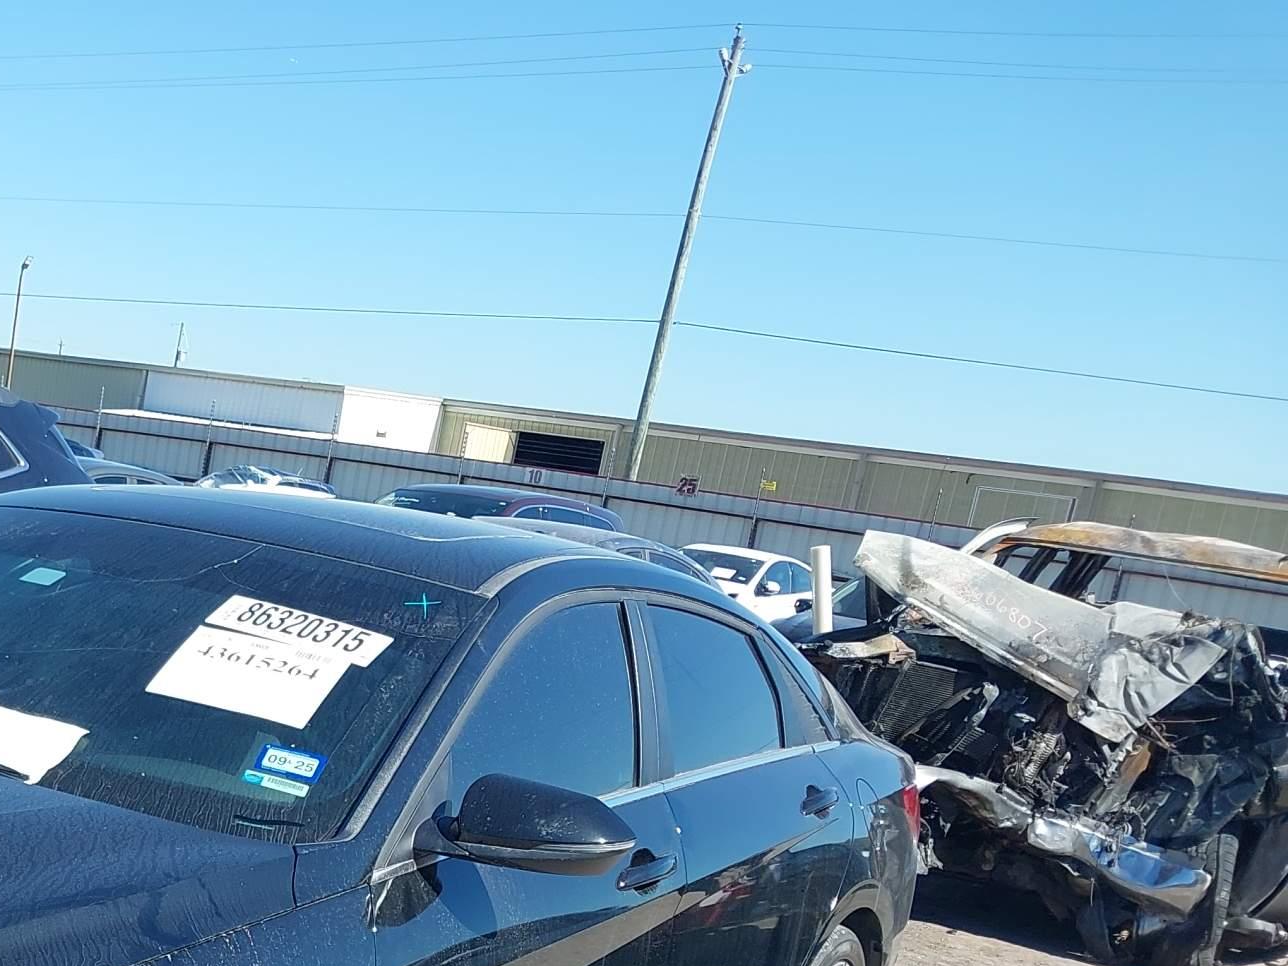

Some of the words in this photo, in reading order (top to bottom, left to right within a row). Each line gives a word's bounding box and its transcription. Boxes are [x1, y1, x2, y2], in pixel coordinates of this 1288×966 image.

[528, 469, 543, 484] 10
[677, 477, 698, 494] 25
[237, 602, 372, 652] 86320315
[197, 645, 320, 680] 43615264
[267, 754, 288, 766] 09
[294, 760, 315, 773] 25
